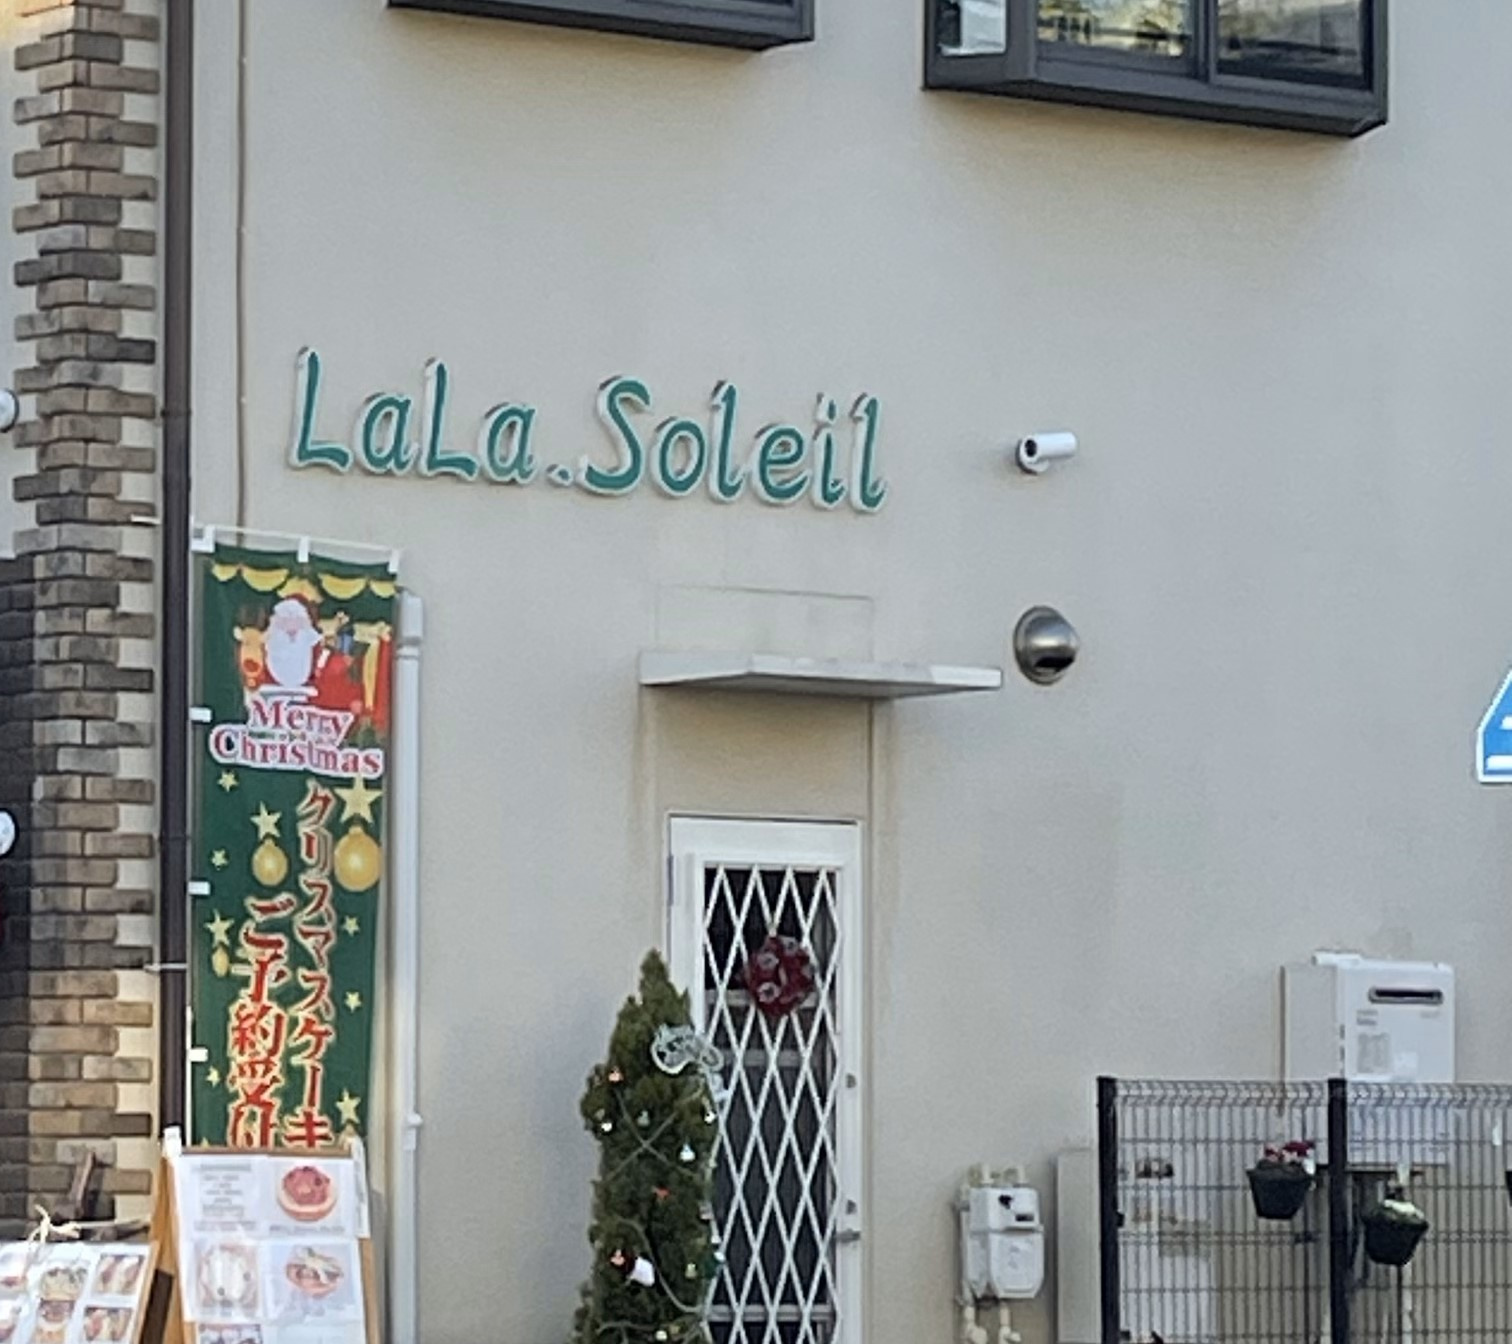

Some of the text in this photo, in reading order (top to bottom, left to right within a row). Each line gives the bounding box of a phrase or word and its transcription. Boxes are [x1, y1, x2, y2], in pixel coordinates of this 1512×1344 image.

[250, 698, 354, 739] Merry
[213, 727, 381, 774] Christmas
[284, 783, 334, 1147] クリスマスケーキ
